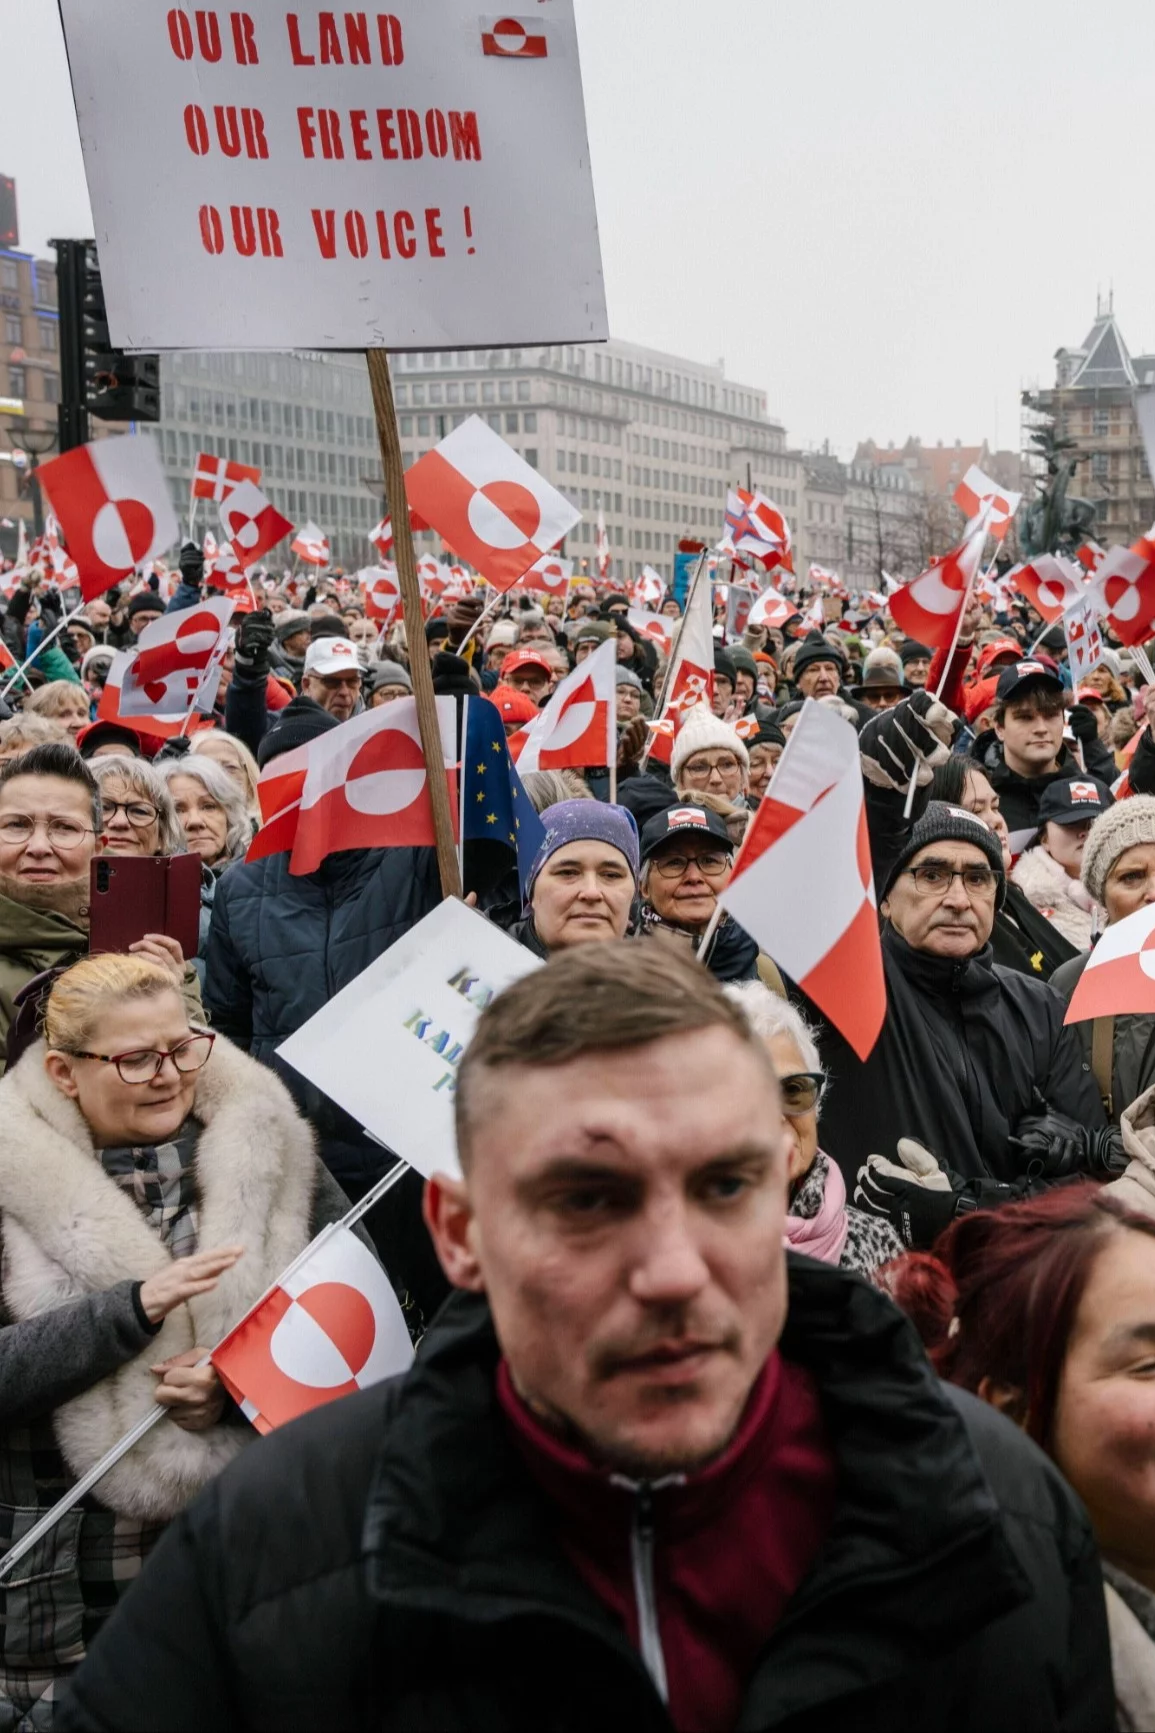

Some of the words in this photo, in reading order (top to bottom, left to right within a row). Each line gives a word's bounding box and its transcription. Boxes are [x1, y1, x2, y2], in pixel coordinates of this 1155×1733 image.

[166, 9, 259, 65] OUR
[286, 12, 405, 66] LAND
[183, 103, 270, 160] OUR
[296, 107, 482, 162] FREEDOM
[198, 205, 284, 258] OUR
